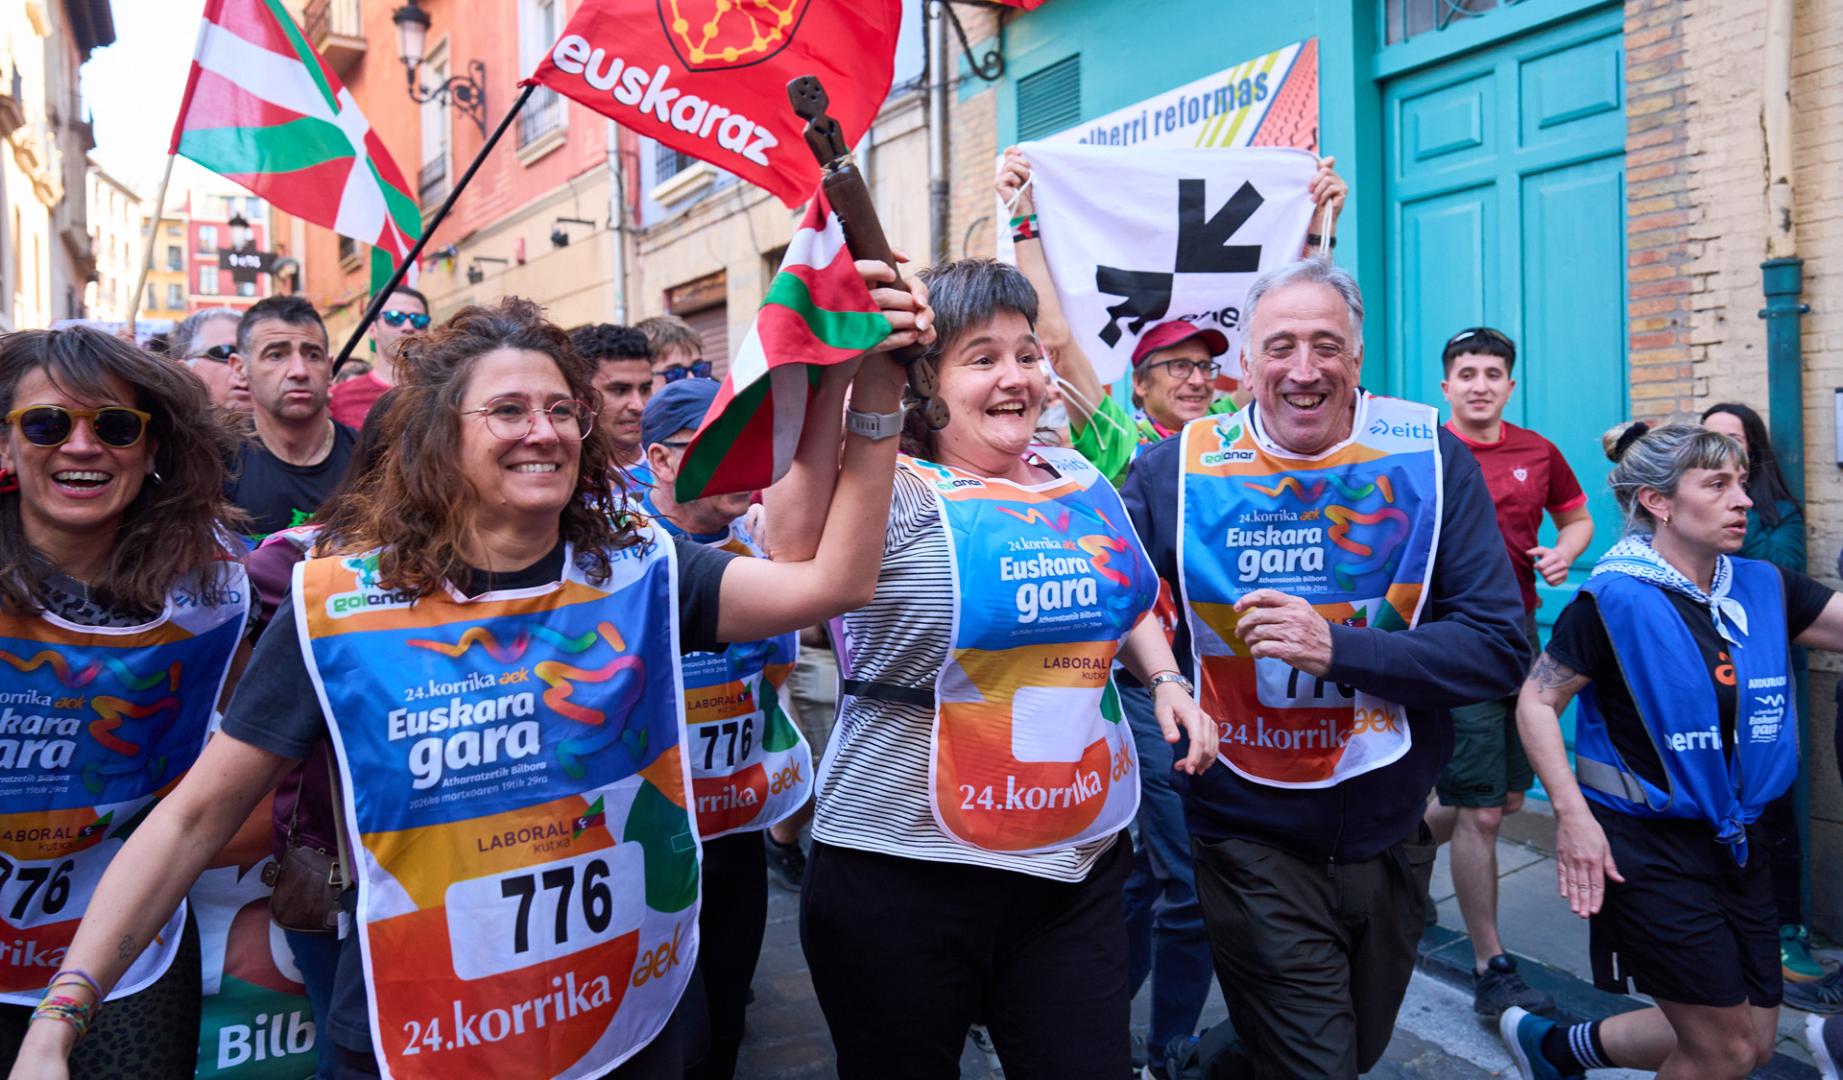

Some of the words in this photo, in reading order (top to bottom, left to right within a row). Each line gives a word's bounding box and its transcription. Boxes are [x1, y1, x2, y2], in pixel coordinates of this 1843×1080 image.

[552, 34, 778, 166] euskaraz
[1154, 72, 1268, 136] reformas
[1392, 423, 1433, 439] eitb
[1239, 509, 1298, 523] 24.korrika
[1226, 525, 1322, 547] Euskara
[1000, 552, 1091, 581] Euskara
[1237, 547, 1324, 582] gara
[1016, 577, 1097, 623] gara
[1043, 656, 1107, 669] LABORAL
[0, 690, 51, 706] orrika
[404, 672, 496, 701] 24.korrika
[498, 667, 529, 685] aek
[0, 708, 81, 736] kara
[388, 692, 535, 741] Euskara
[0, 739, 77, 770] ara
[408, 720, 541, 790] gara
[700, 718, 753, 770] 776
[511, 762, 547, 775] Bilbora
[771, 755, 804, 794] aek
[698, 784, 758, 813] rrika
[960, 768, 1103, 811] 24.korrika
[2, 827, 74, 843] ABORAL
[477, 821, 569, 852] LABORAL
[533, 837, 571, 853] kutxa
[501, 859, 613, 954] 776
[633, 923, 681, 988] aek
[402, 971, 613, 1056] 24.korrika
[216, 1010, 317, 1070] Bilb
